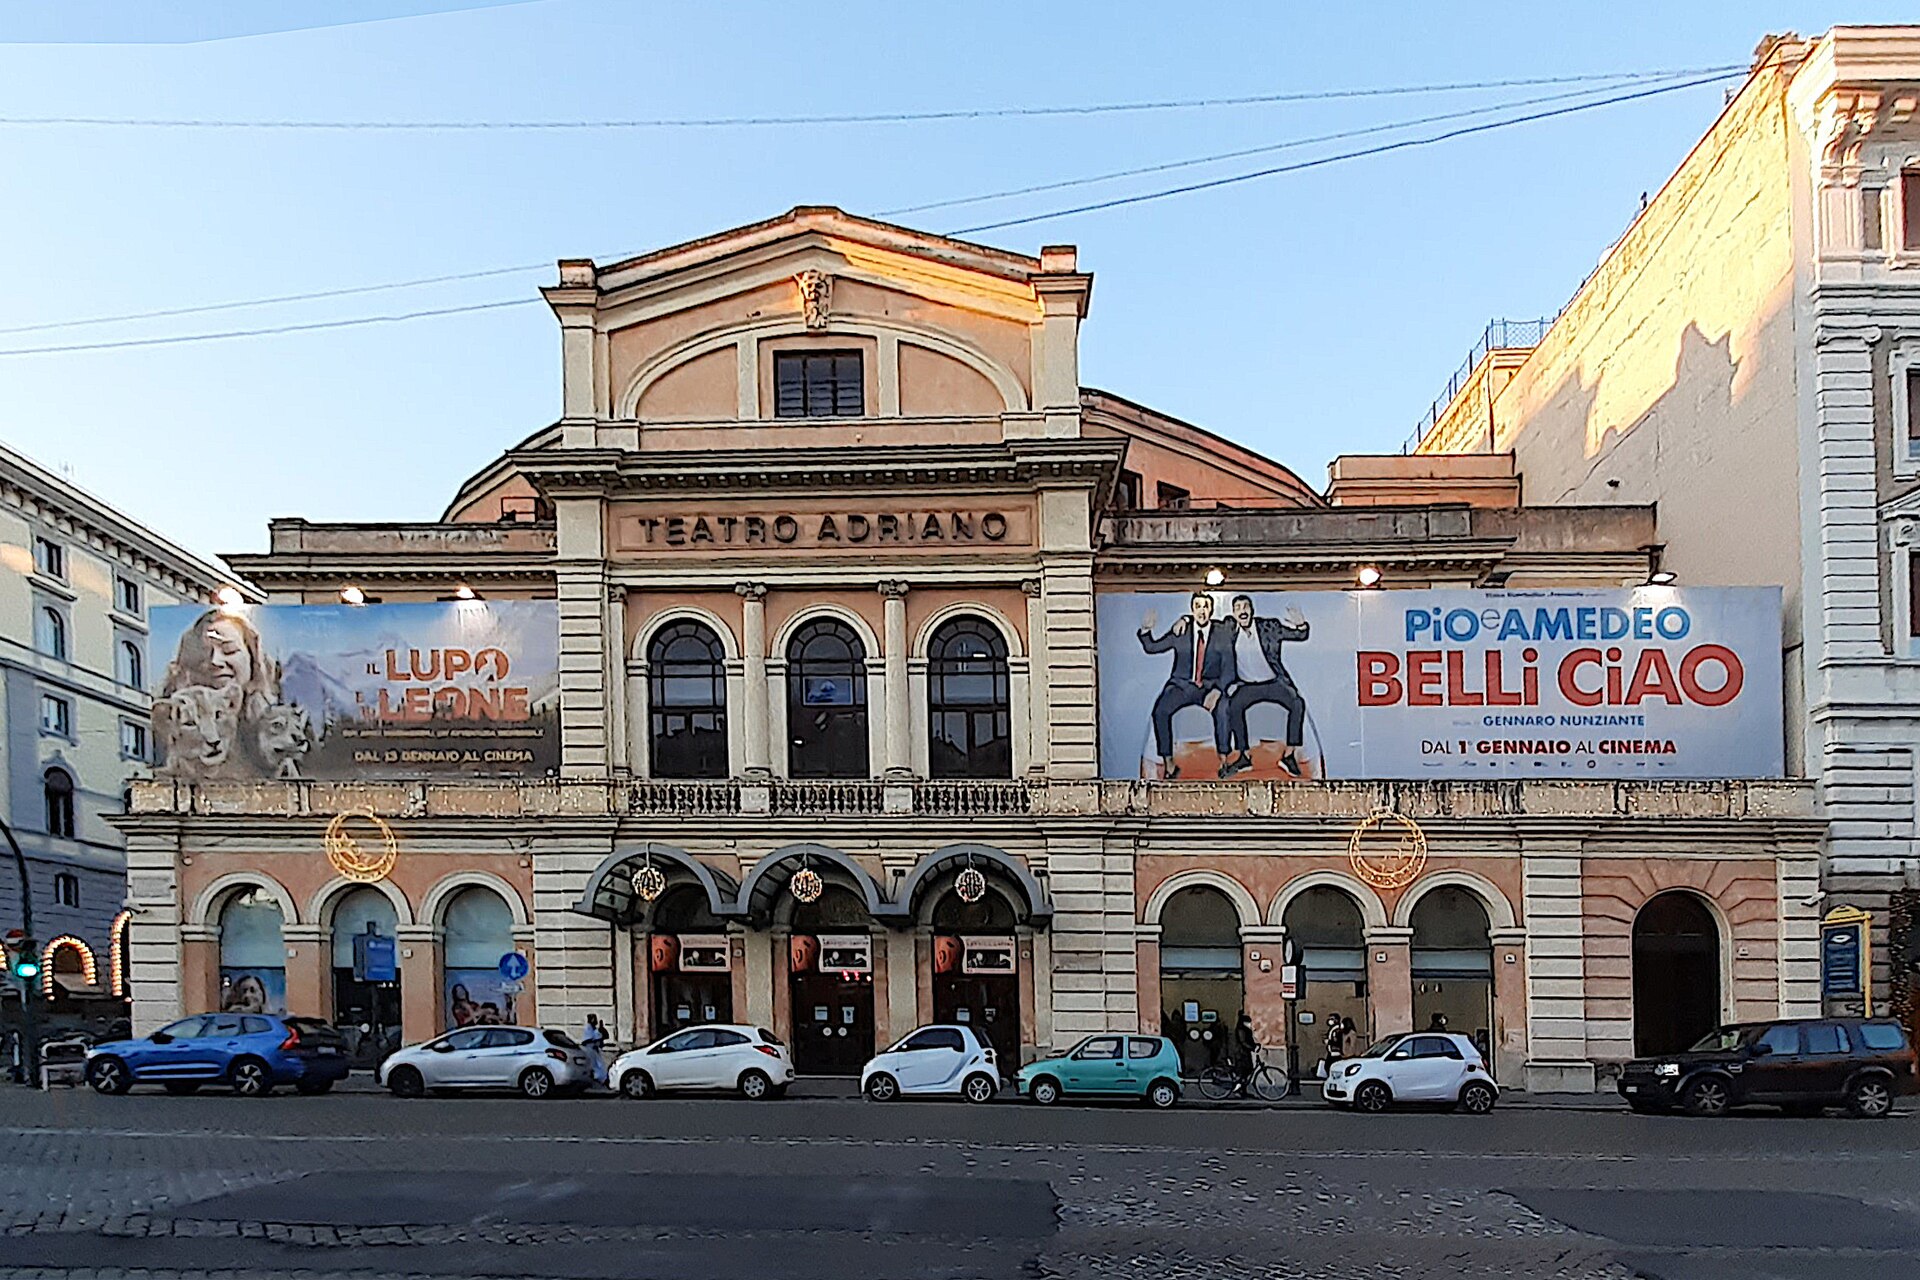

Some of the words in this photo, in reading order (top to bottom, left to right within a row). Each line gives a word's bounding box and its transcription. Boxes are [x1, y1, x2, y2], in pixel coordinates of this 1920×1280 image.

[638, 514, 798, 545] TEATRO
[817, 512, 1007, 543] ADRIANO
[1498, 606, 1691, 642] AMEDEO
[366, 663, 380, 675] IL
[386, 648, 509, 682] LUPO
[1356, 647, 1540, 708] BELLi
[1557, 643, 1744, 708] CiAO
[379, 686, 529, 722] LEONE
[1483, 715, 1556, 727] GENNARO
[1560, 715, 1645, 727] NUNZIANTE
[353, 749, 380, 762] DAL
[462, 749, 480, 762] AL
[483, 749, 534, 762] CINEMA
[1421, 740, 1452, 754] DAL
[1476, 740, 1571, 754] GENNAIO
[1575, 740, 1595, 754] AL
[1598, 740, 1677, 754] CINEMA
